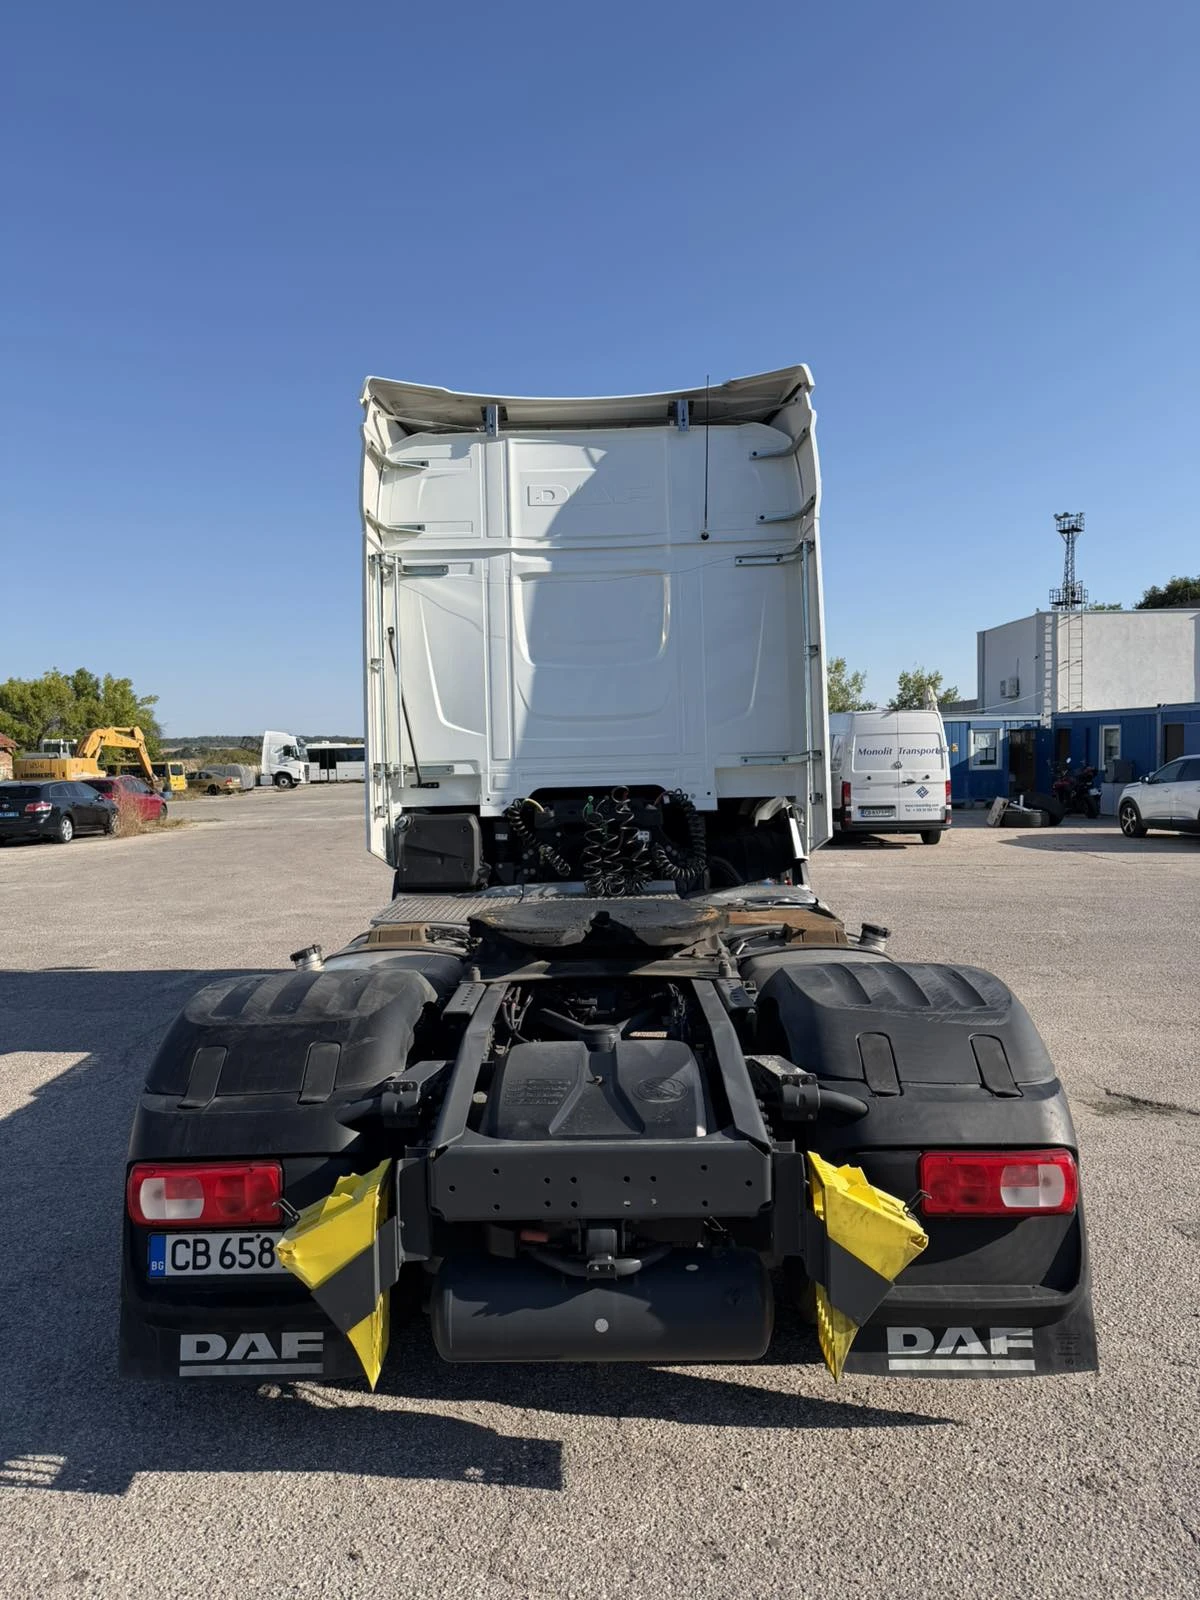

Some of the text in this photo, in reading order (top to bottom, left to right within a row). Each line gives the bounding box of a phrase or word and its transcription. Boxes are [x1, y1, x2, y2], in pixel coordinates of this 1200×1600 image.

[858, 747, 893, 756] Monolit
[151, 1260, 165, 1271] BG
[170, 1236, 287, 1271] CB 658
[179, 1332, 324, 1361] DAF
[886, 1326, 1034, 1355] DAF
